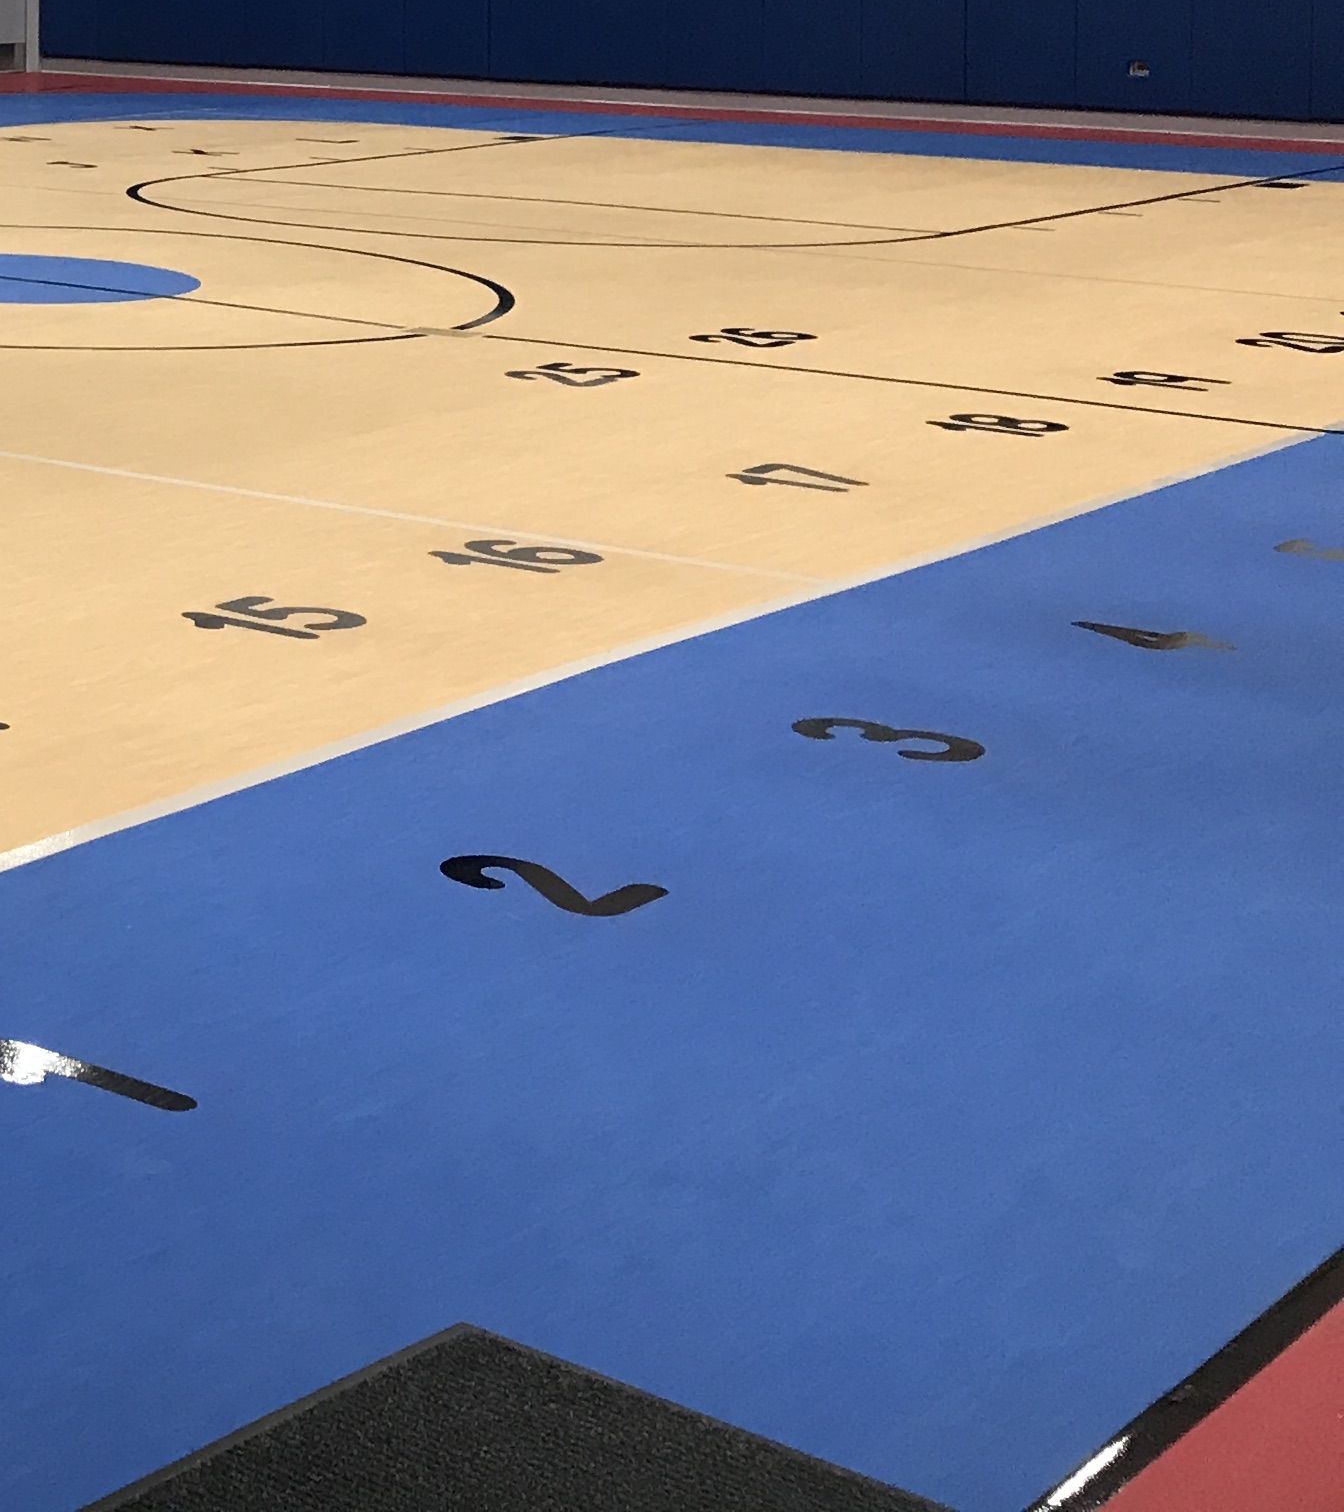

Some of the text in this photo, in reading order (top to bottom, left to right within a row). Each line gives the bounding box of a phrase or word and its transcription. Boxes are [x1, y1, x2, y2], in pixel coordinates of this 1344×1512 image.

[689, 328, 818, 347] 26
[505, 363, 640, 387] 25
[1096, 371, 1232, 391] 19
[925, 414, 1069, 437] 18
[725, 464, 869, 492] 17
[428, 540, 604, 573] 16
[181, 596, 367, 639] 15
[791, 717, 986, 762] 3
[440, 855, 669, 916] 2
